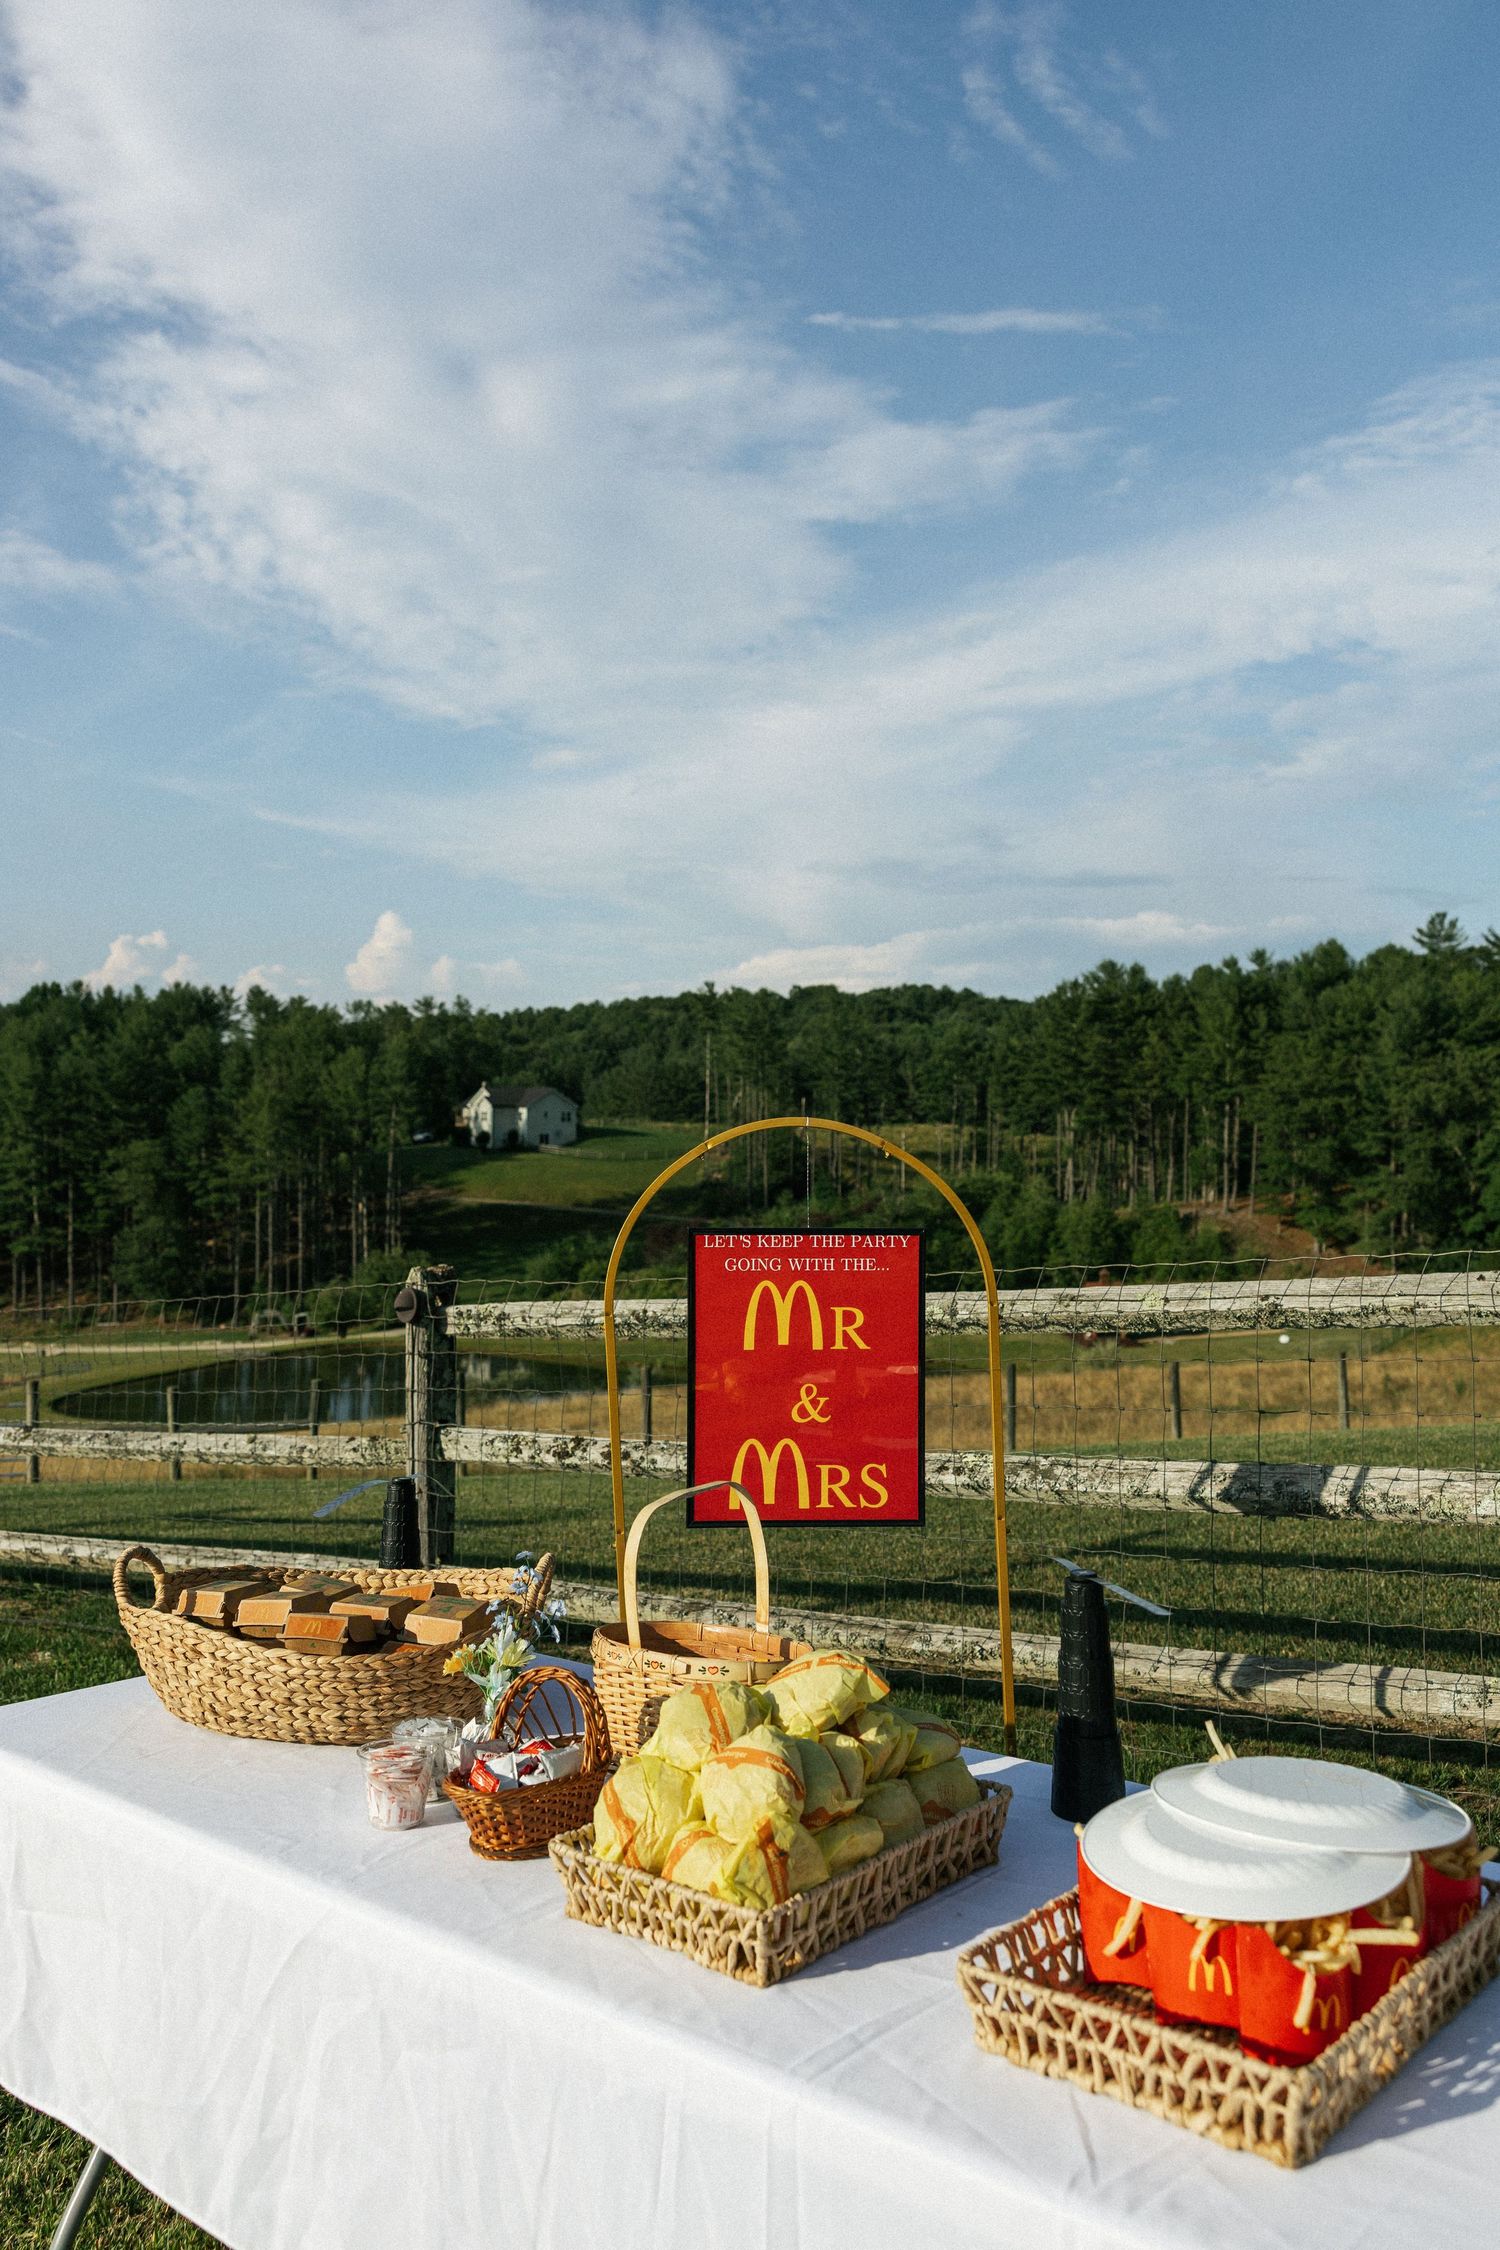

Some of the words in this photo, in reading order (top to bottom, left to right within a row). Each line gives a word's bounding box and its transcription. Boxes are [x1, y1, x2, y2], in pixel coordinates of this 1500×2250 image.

[703, 1234, 751, 1248] LET'S
[757, 1234, 804, 1248] KEEP
[809, 1234, 845, 1248] THE
[850, 1234, 911, 1248] PARTY
[724, 1257, 782, 1272] GOING
[788, 1257, 835, 1272] WITH
[841, 1257, 890, 1272] THE...
[790, 1383, 832, 1424] &
[728, 1438, 889, 1510] MRS
